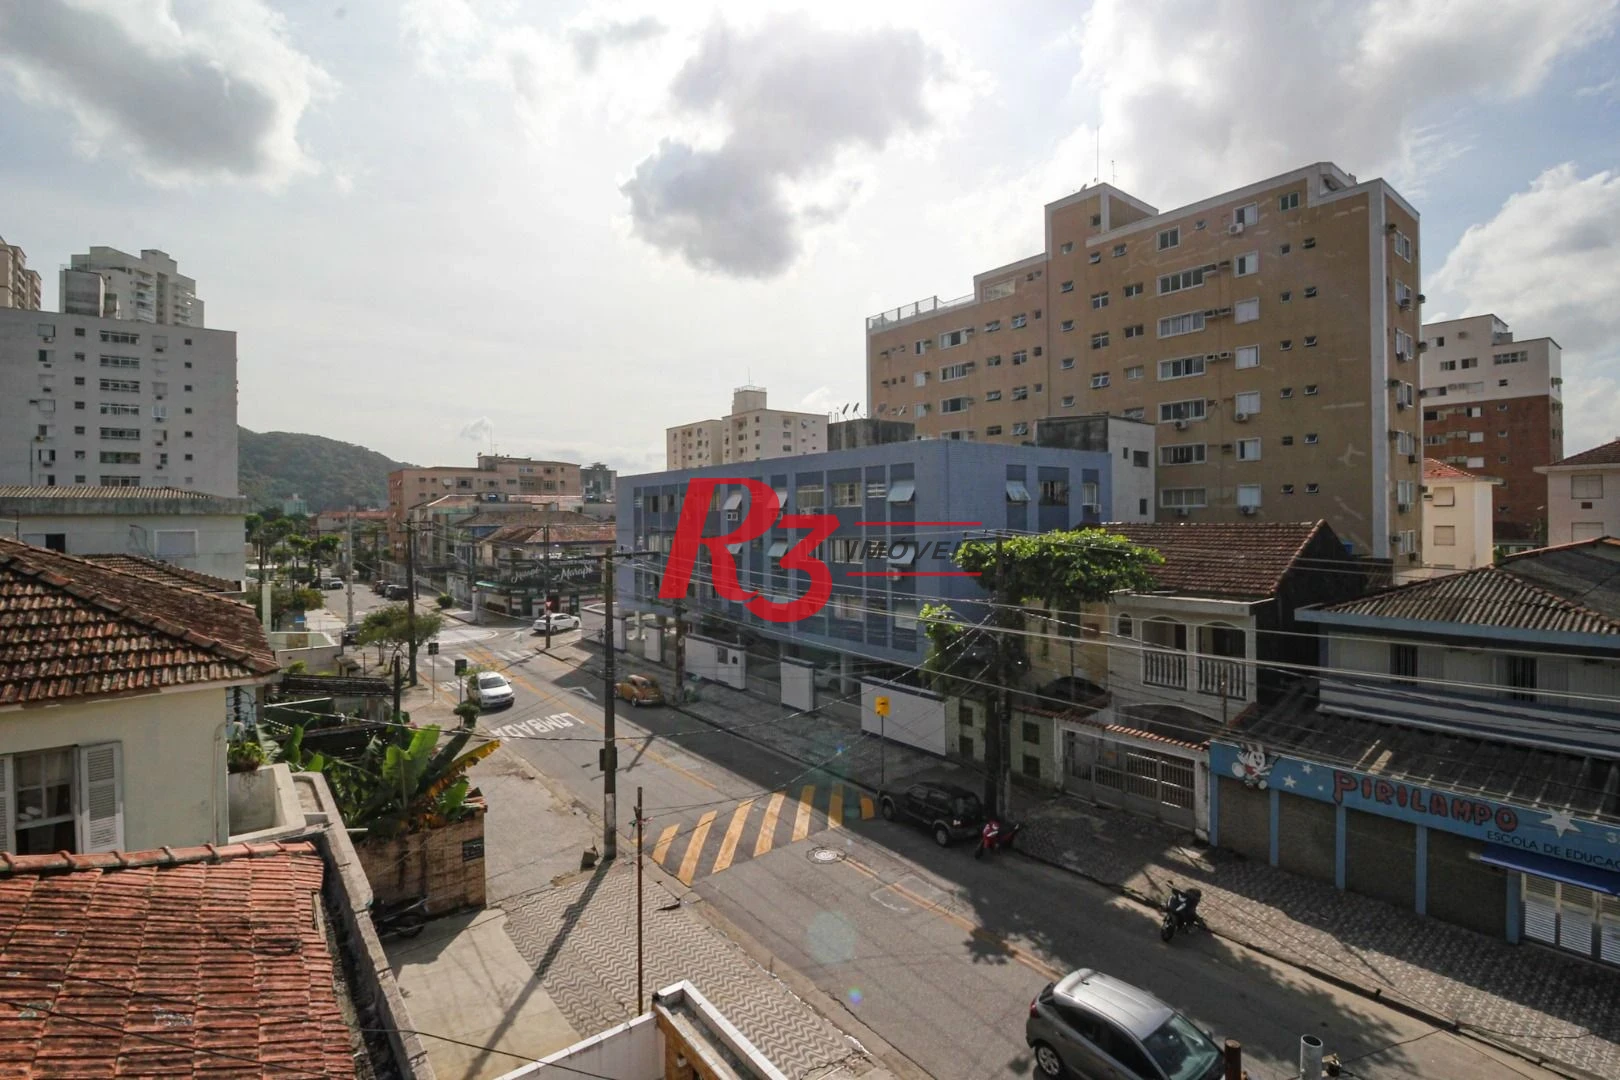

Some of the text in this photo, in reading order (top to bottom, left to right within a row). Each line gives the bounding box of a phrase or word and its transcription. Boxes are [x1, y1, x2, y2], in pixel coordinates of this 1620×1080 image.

[490, 712, 585, 742] LOMBADA
[1333, 768, 1518, 833] PIRILAMPO
[1487, 830, 1538, 850] ESCOLA
[1543, 843, 1561, 855] DE
